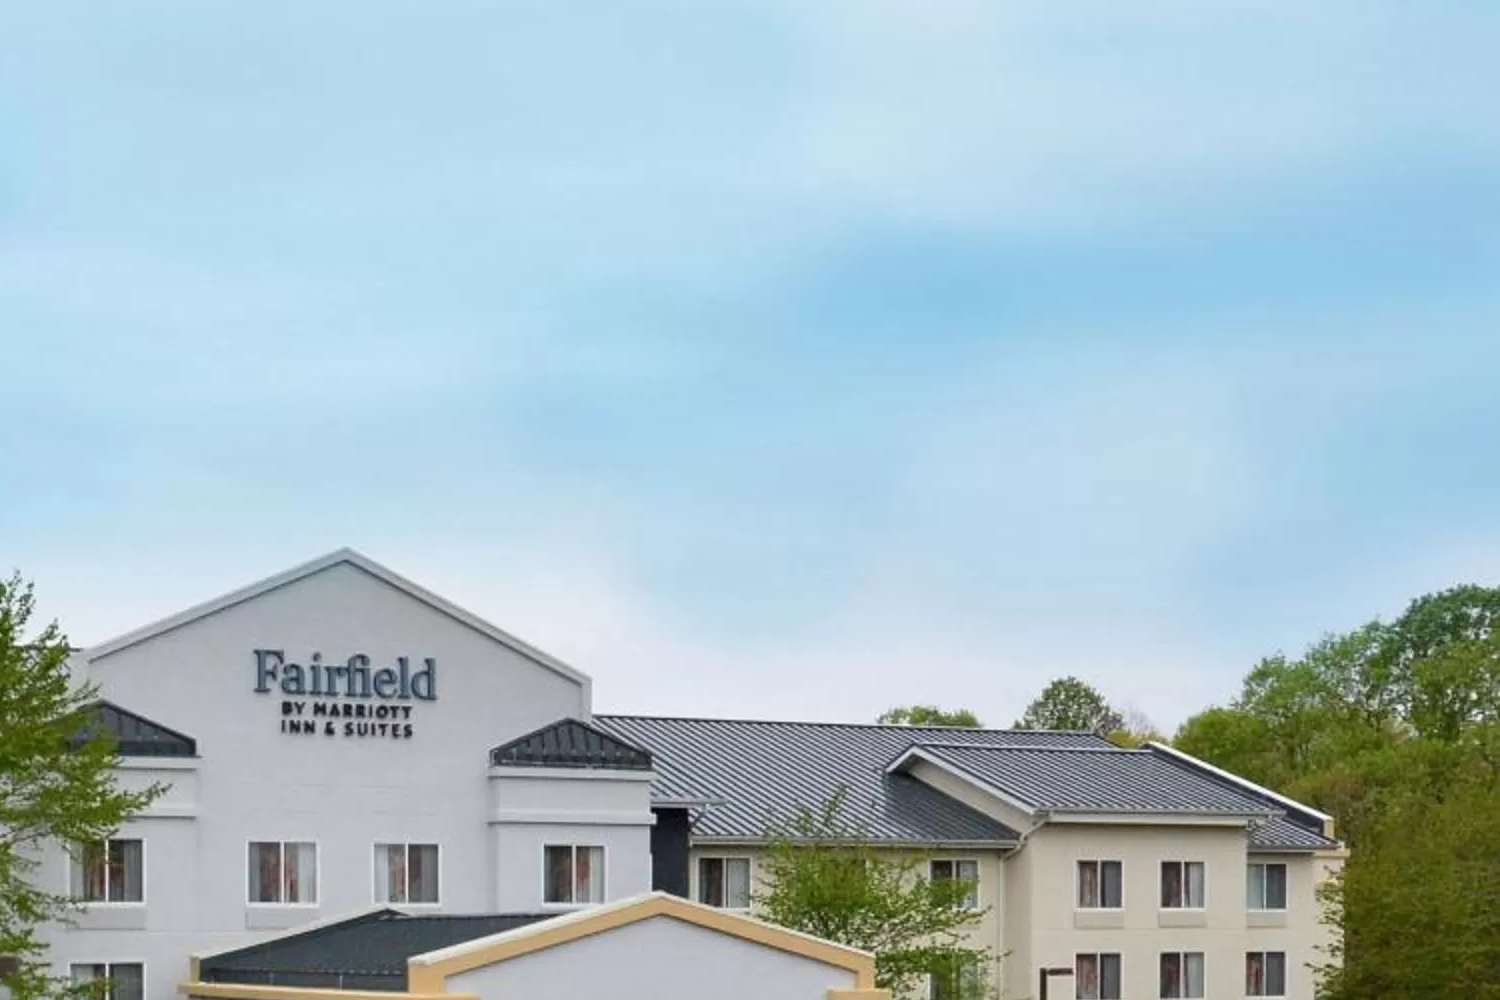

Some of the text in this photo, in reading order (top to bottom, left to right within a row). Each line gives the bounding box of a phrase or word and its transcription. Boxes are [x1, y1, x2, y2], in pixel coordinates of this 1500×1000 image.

[253, 649, 437, 701] Fairfield
[281, 701, 413, 719] BY MARRIOTT
[281, 719, 413, 738] INN & SUITES
